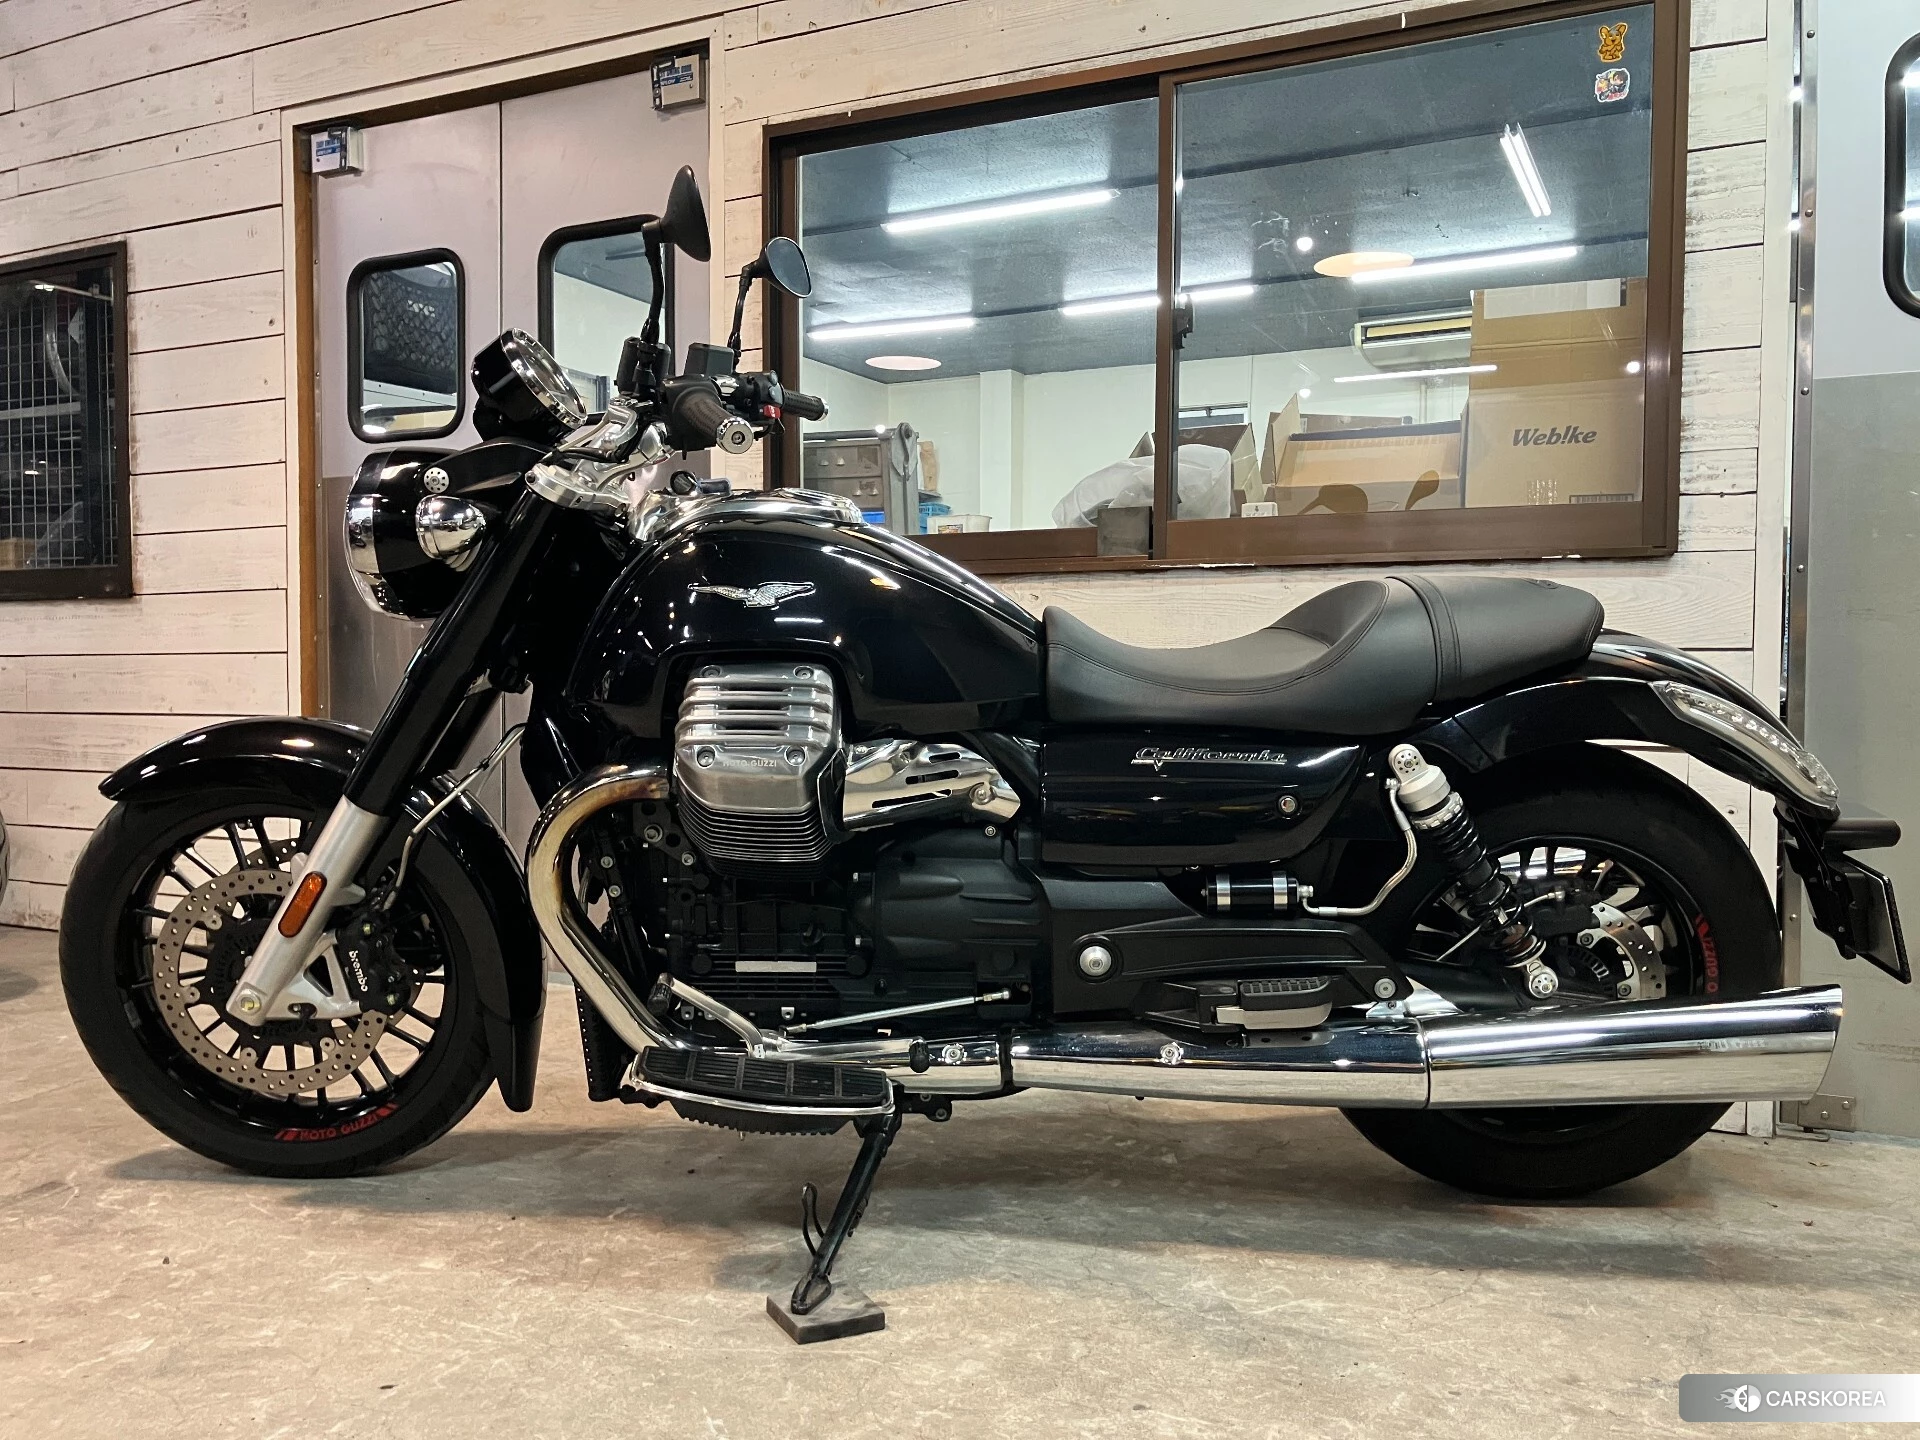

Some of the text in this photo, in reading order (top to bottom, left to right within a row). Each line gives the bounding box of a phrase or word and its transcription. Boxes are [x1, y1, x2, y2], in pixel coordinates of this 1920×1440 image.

[750, 759, 777, 768] GUZZI
[1132, 747, 1288, 765] California
[348, 950, 369, 992] brembo
[300, 1113, 378, 1141] MOTO GUZZI
